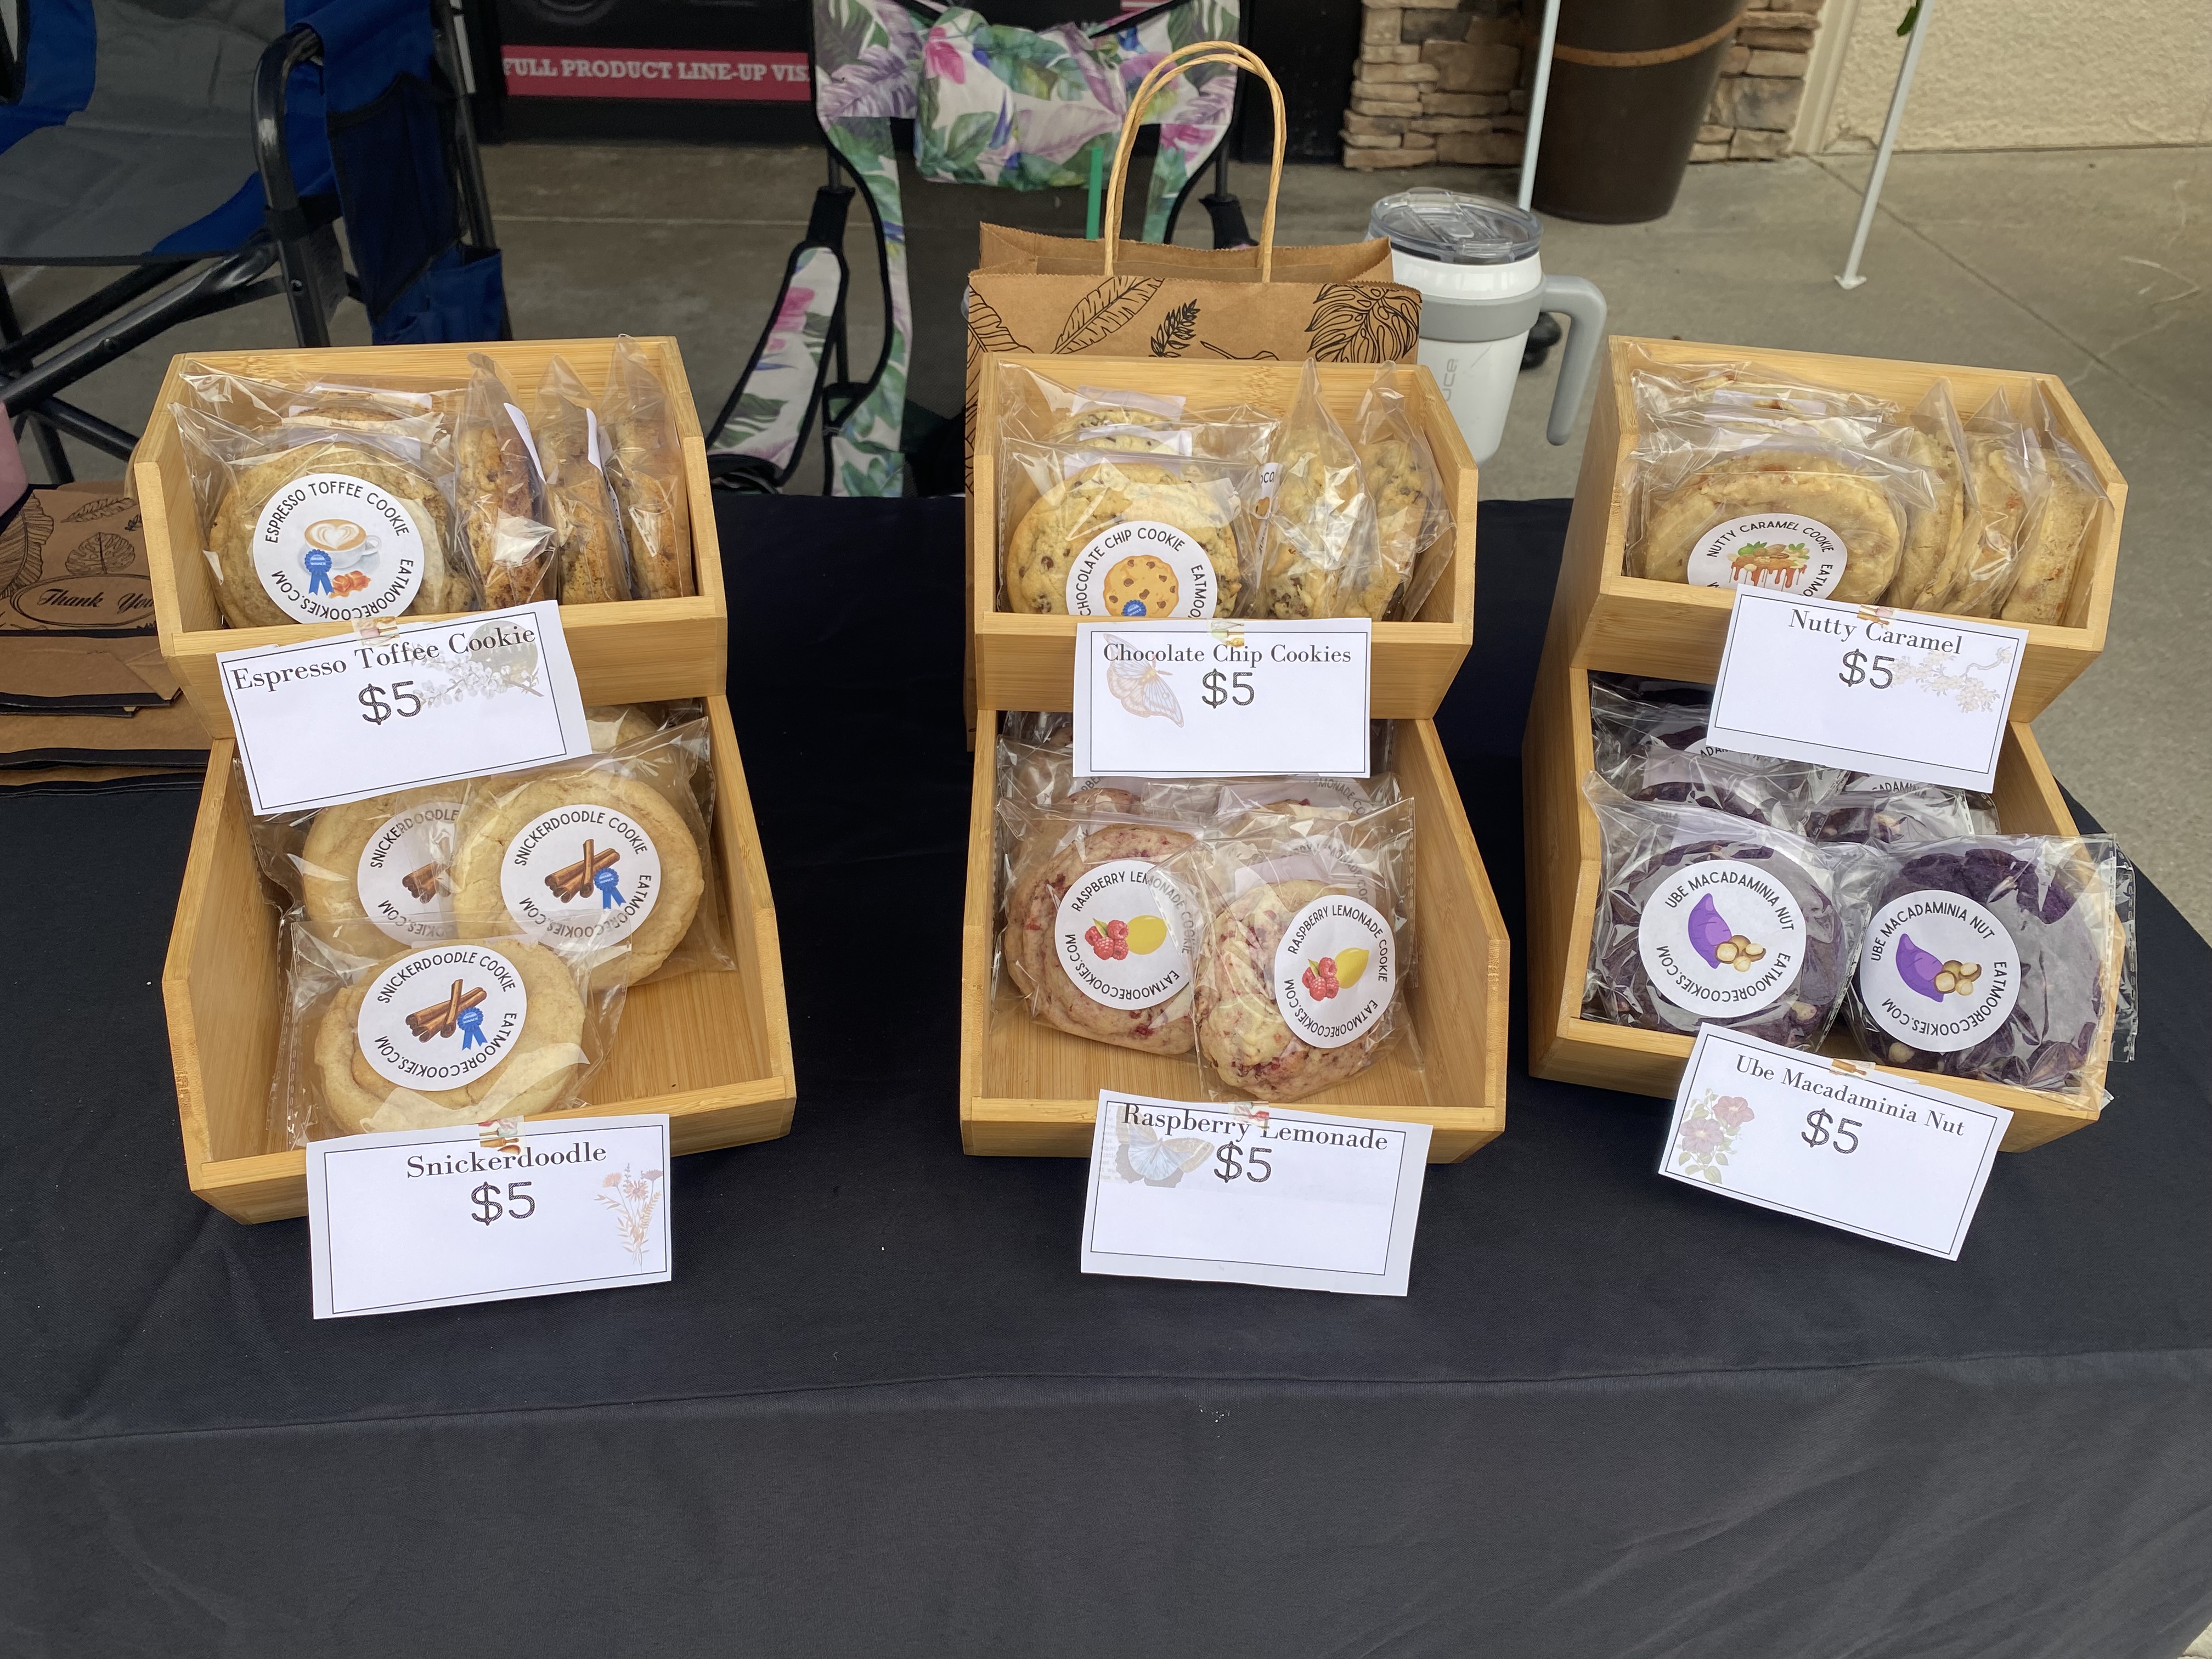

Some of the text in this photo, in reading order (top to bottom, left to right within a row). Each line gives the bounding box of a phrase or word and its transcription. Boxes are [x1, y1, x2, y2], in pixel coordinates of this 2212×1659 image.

[502, 58, 811, 82] FULL PRODUCT LINE-UP VIS
[265, 481, 409, 543] ESPRESSO TOFFEE COOKIE
[1104, 529, 1132, 549] CHIP
[1138, 528, 1185, 552] COOKIE
[1707, 521, 1834, 557] NUTTY CARAMEL COOKIE
[37, 589, 104, 608] Thank
[271, 559, 414, 620] EATMOORECOOKIES.COM
[1187, 565, 1207, 618] EATMOO
[1103, 643, 1351, 668] Chocolate Chip Cookies
[1788, 609, 1963, 654] Nutty Caramel
[230, 626, 536, 692] Espresso Toffee Cookie
[1838, 648, 1895, 689] $5
[358, 680, 422, 726] $5
[1201, 669, 1255, 709] $5
[370, 809, 459, 868] SNICKERDOODLE
[514, 811, 648, 866] SNICKERDOODLE COOKIE
[1071, 871, 1125, 912] RASPBERRY
[1181, 911, 1196, 955] COOKIE
[1665, 871, 1795, 930] UBE MACADAMINIA NUT
[1288, 905, 1388, 982] RASPBERRY LEMONADE COOKIE
[1871, 901, 1996, 961] UBE MACADAMINIA NUT
[377, 951, 516, 1003] SNICKERDOODLE COOKIE
[1065, 934, 1180, 1000] EATMOORECOOKIES.COM
[1656, 946, 1791, 1002] EATMOORECOOKIES.COM
[1284, 979, 1379, 1037] EATMOORECOOKIES.COM
[1882, 961, 2007, 1036] EATMOORECOOKIES.COM
[374, 1013, 517, 1078] EATMOORECOOKIES.COM
[1736, 1054, 1965, 1136] Ube Macadaminia Nut
[1121, 1103, 1252, 1142] Raspberry
[1801, 1108, 1863, 1154] $5
[407, 1141, 607, 1178] Snickerdoodle
[1214, 1141, 1272, 1183] $5
[471, 1181, 536, 1226] $5
